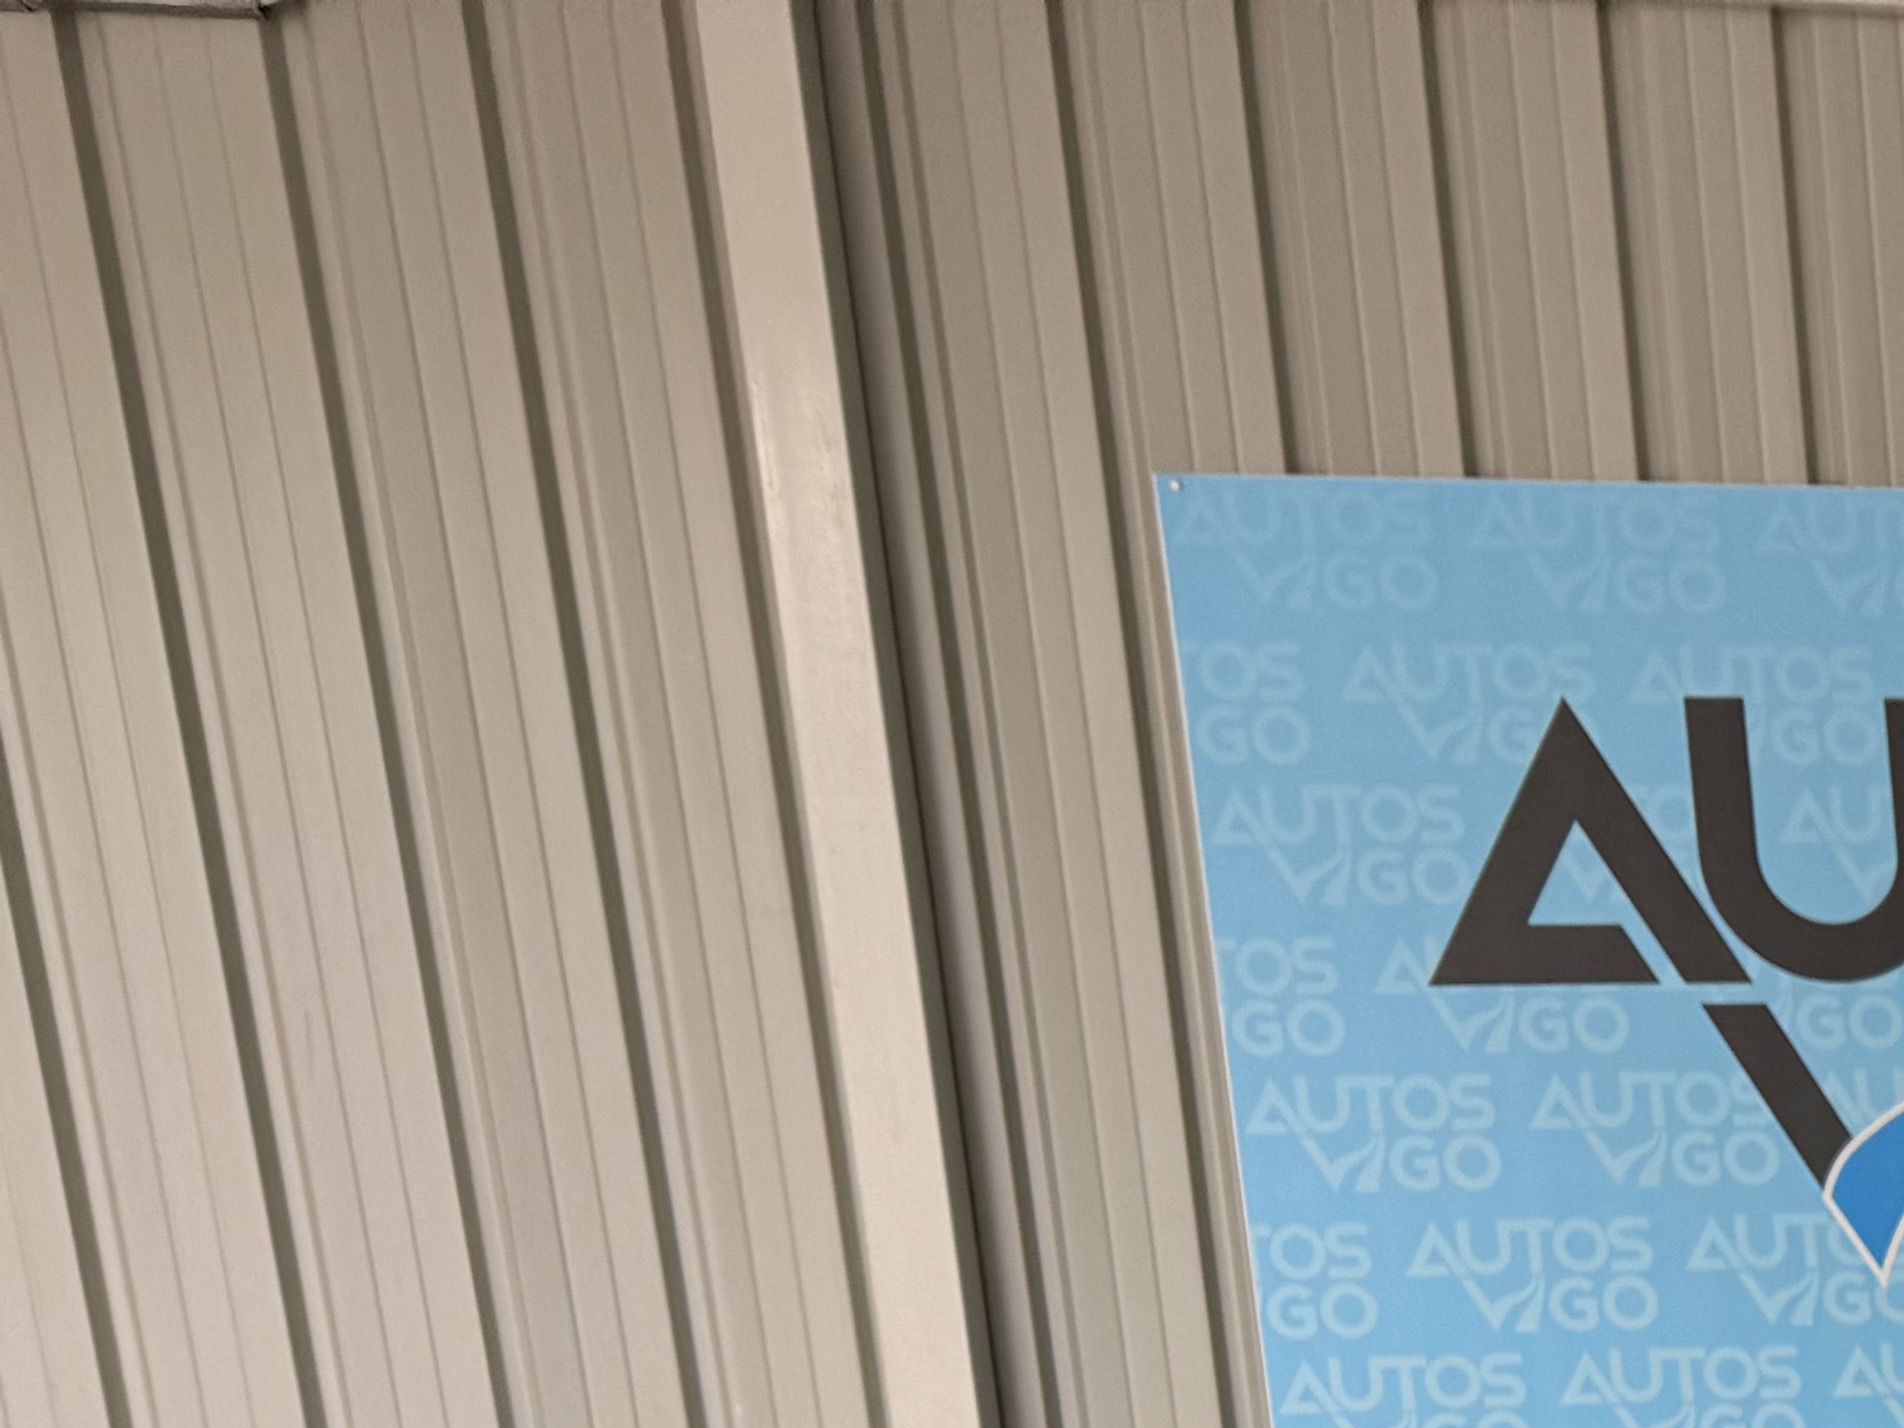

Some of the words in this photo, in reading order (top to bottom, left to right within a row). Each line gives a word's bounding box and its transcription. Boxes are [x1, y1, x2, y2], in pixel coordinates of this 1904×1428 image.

[1175, 488, 1432, 547] AUTOS
[1468, 490, 1720, 550] AUTOS
[1231, 549, 1438, 612] VIGO
[1524, 551, 1728, 612] VIGO
[1340, 640, 1596, 701] AUTOS
[1629, 642, 1874, 704] AUTOS
[1211, 783, 1465, 844] AUTOS
[1266, 847, 1471, 906] VIGO
[1428, 997, 1629, 1054] VIGO
[1245, 1072, 1496, 1135] AUTOS
[1301, 1133, 1501, 1194] VIGO
[1584, 1130, 1780, 1188] VIGO
[1406, 1215, 1654, 1278] AUTOS
[1463, 1273, 1659, 1333] VIGO
[1280, 1353, 1526, 1415] AUTOS
[1560, 1344, 1802, 1407] AUTOS
